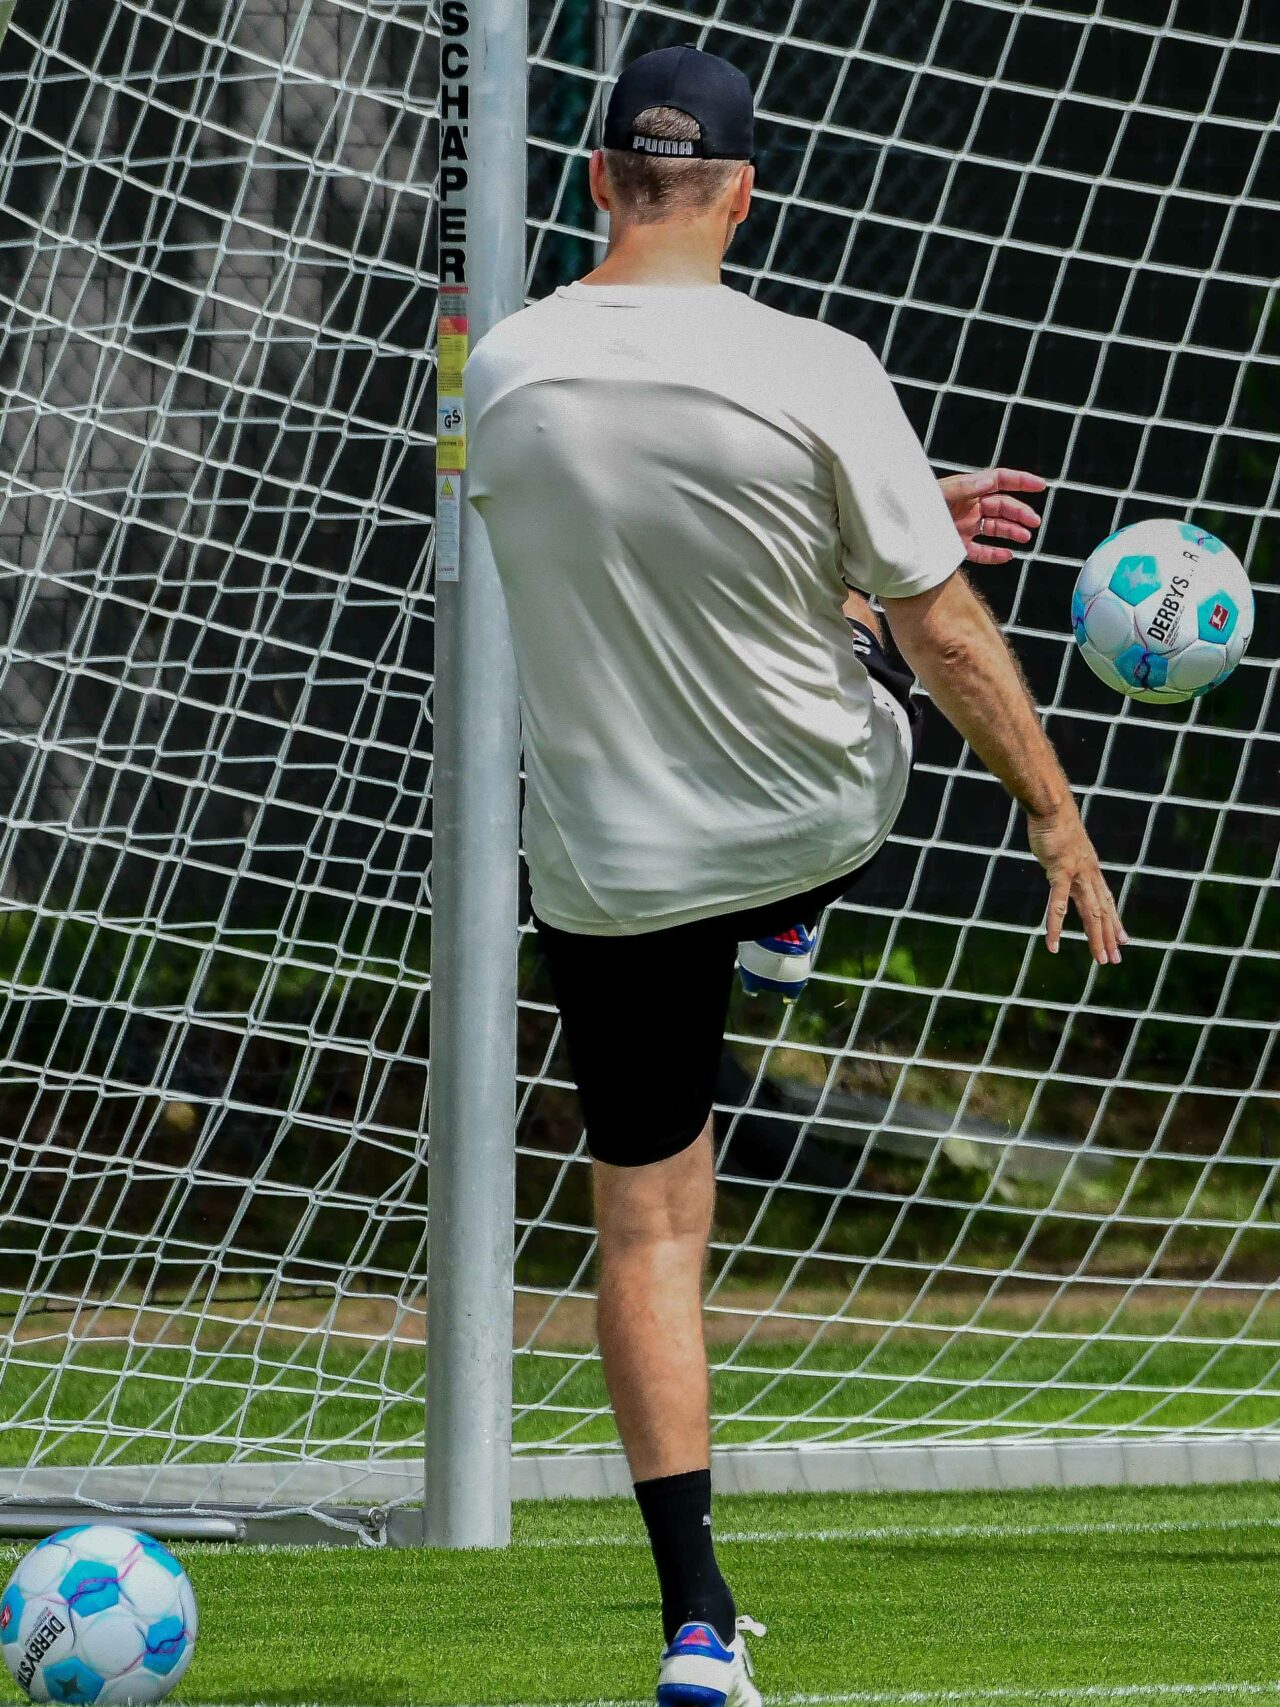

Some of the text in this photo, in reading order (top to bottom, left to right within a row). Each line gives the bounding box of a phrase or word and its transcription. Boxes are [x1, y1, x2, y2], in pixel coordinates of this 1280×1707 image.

[440, 1, 470, 283] SCHÄPER
[632, 135, 694, 155] PUMA
[1146, 550, 1200, 642] DERBYSR
